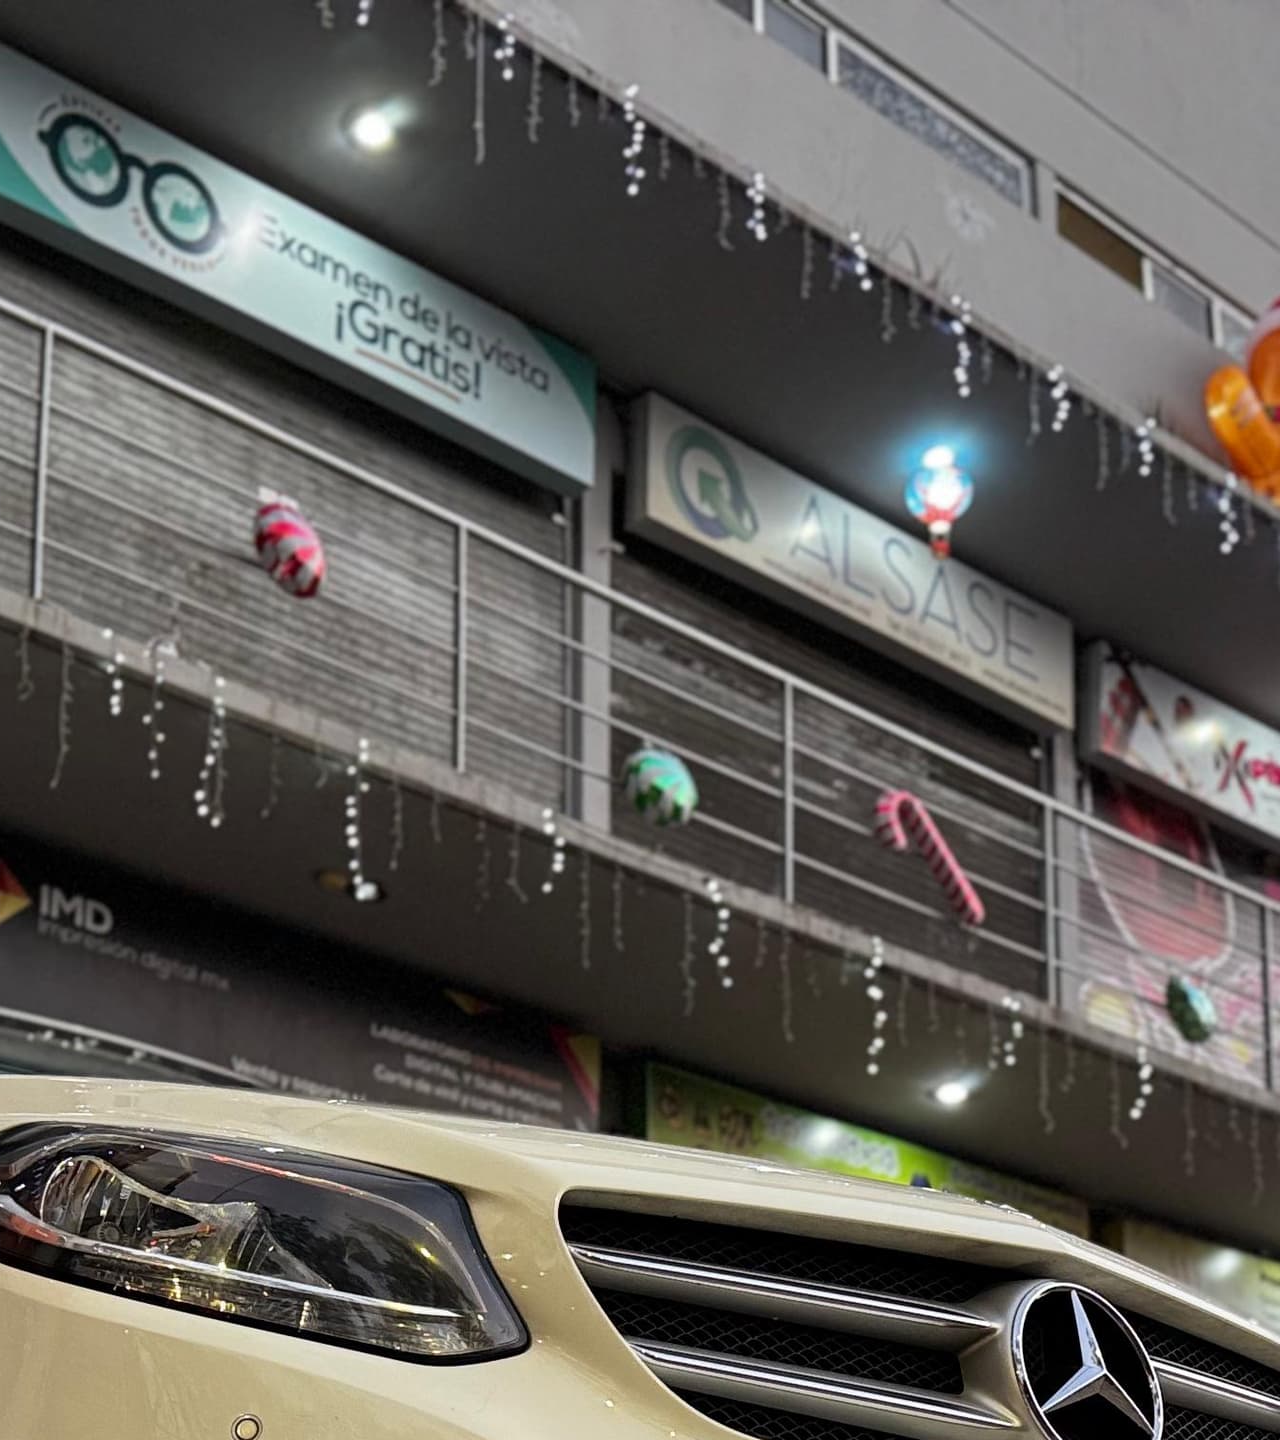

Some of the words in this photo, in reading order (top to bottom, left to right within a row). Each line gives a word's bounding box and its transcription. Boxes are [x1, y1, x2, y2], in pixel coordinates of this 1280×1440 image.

[261, 213, 394, 310] Examen
[398, 292, 440, 333] de
[445, 311, 472, 350] la
[476, 334, 549, 395] vista
[334, 300, 482, 399] ¡Gratis!
[788, 493, 1041, 685] ALSASE
[39, 883, 115, 936] IMD
